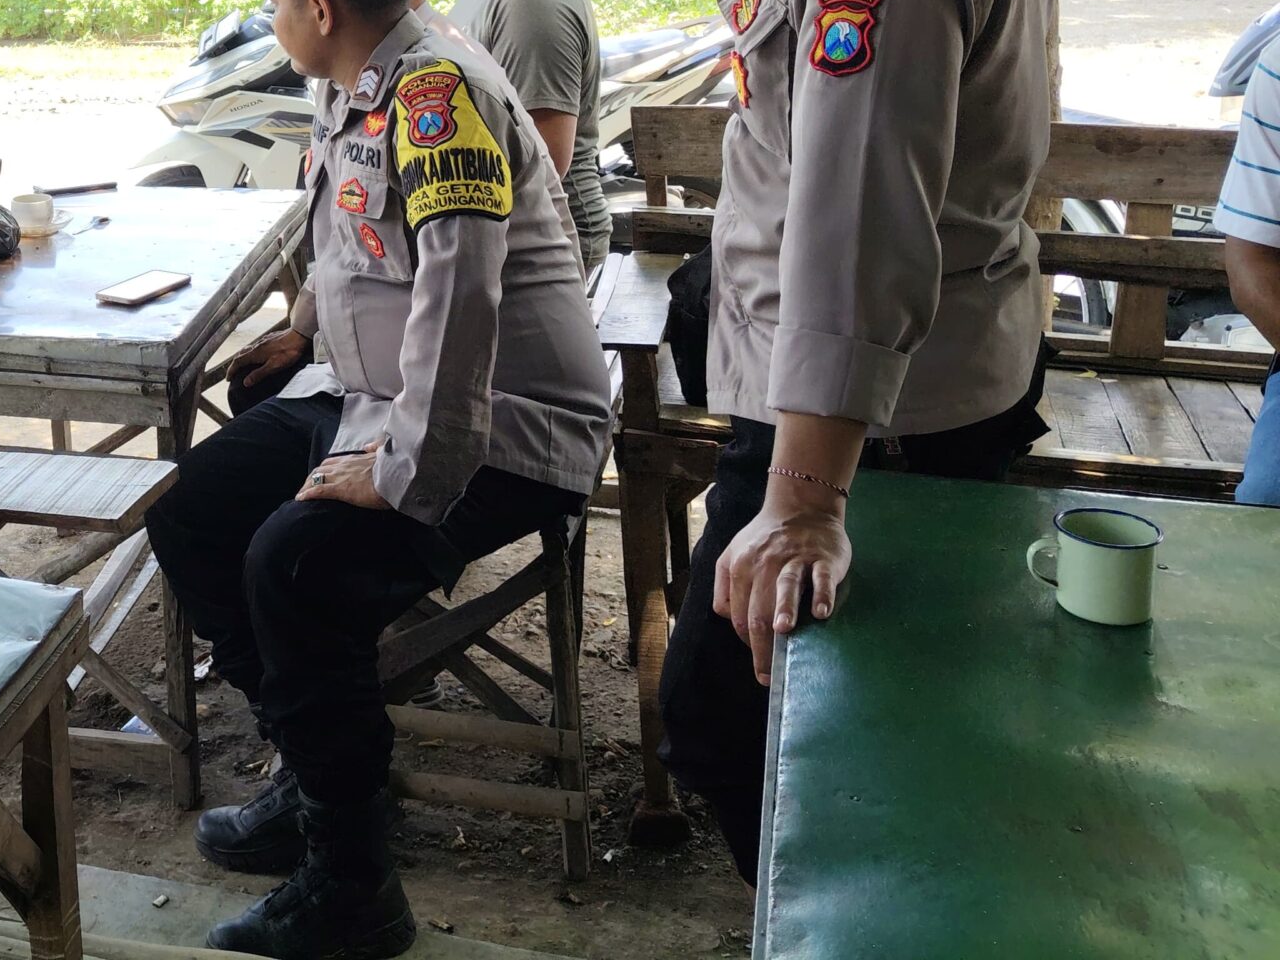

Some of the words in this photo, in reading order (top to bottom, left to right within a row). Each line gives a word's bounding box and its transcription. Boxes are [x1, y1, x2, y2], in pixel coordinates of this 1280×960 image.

[401, 76, 451, 95] POLRES
[230, 98, 264, 113] HONDA
[343, 140, 381, 170] POLRI
[436, 183, 494, 197] GETAS
[414, 194, 503, 215] TANJUNGANOM
